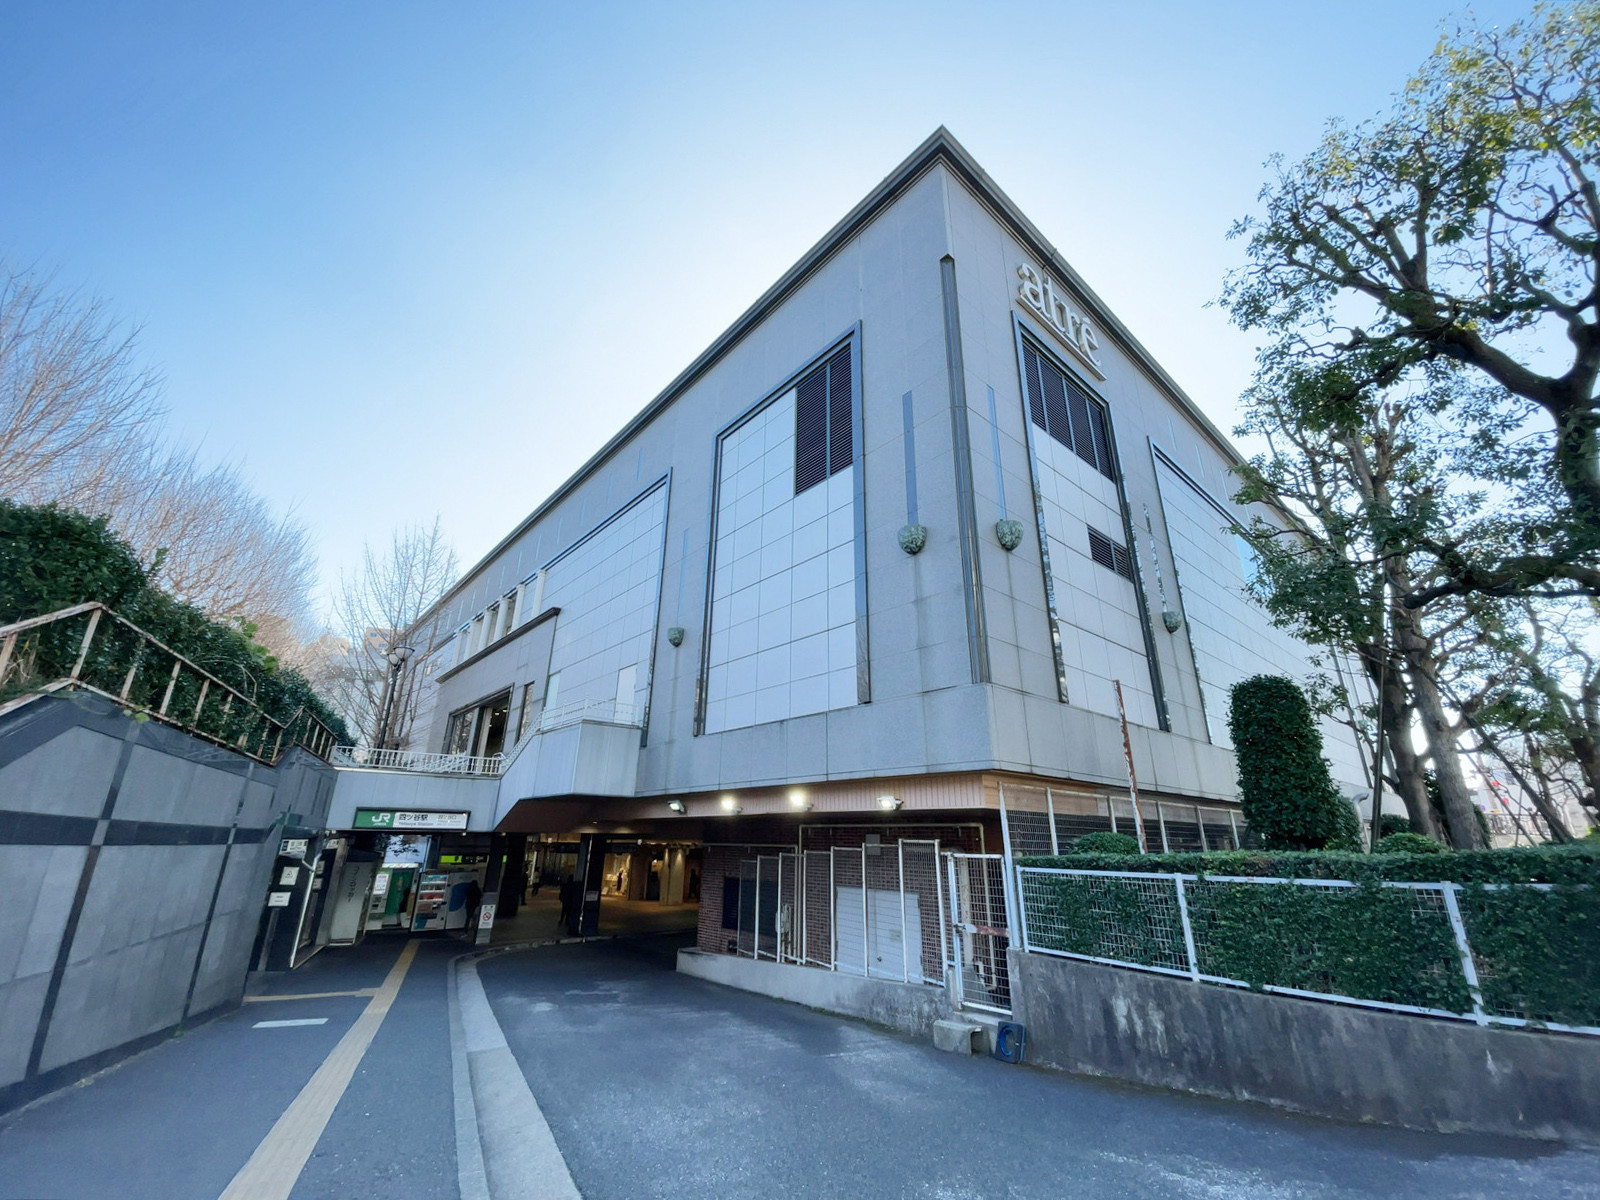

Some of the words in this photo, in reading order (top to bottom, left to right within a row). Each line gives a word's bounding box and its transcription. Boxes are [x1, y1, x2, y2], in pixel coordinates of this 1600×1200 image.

[371, 813, 391, 822] JR
[398, 813, 428, 821] 四ツ谷駅
